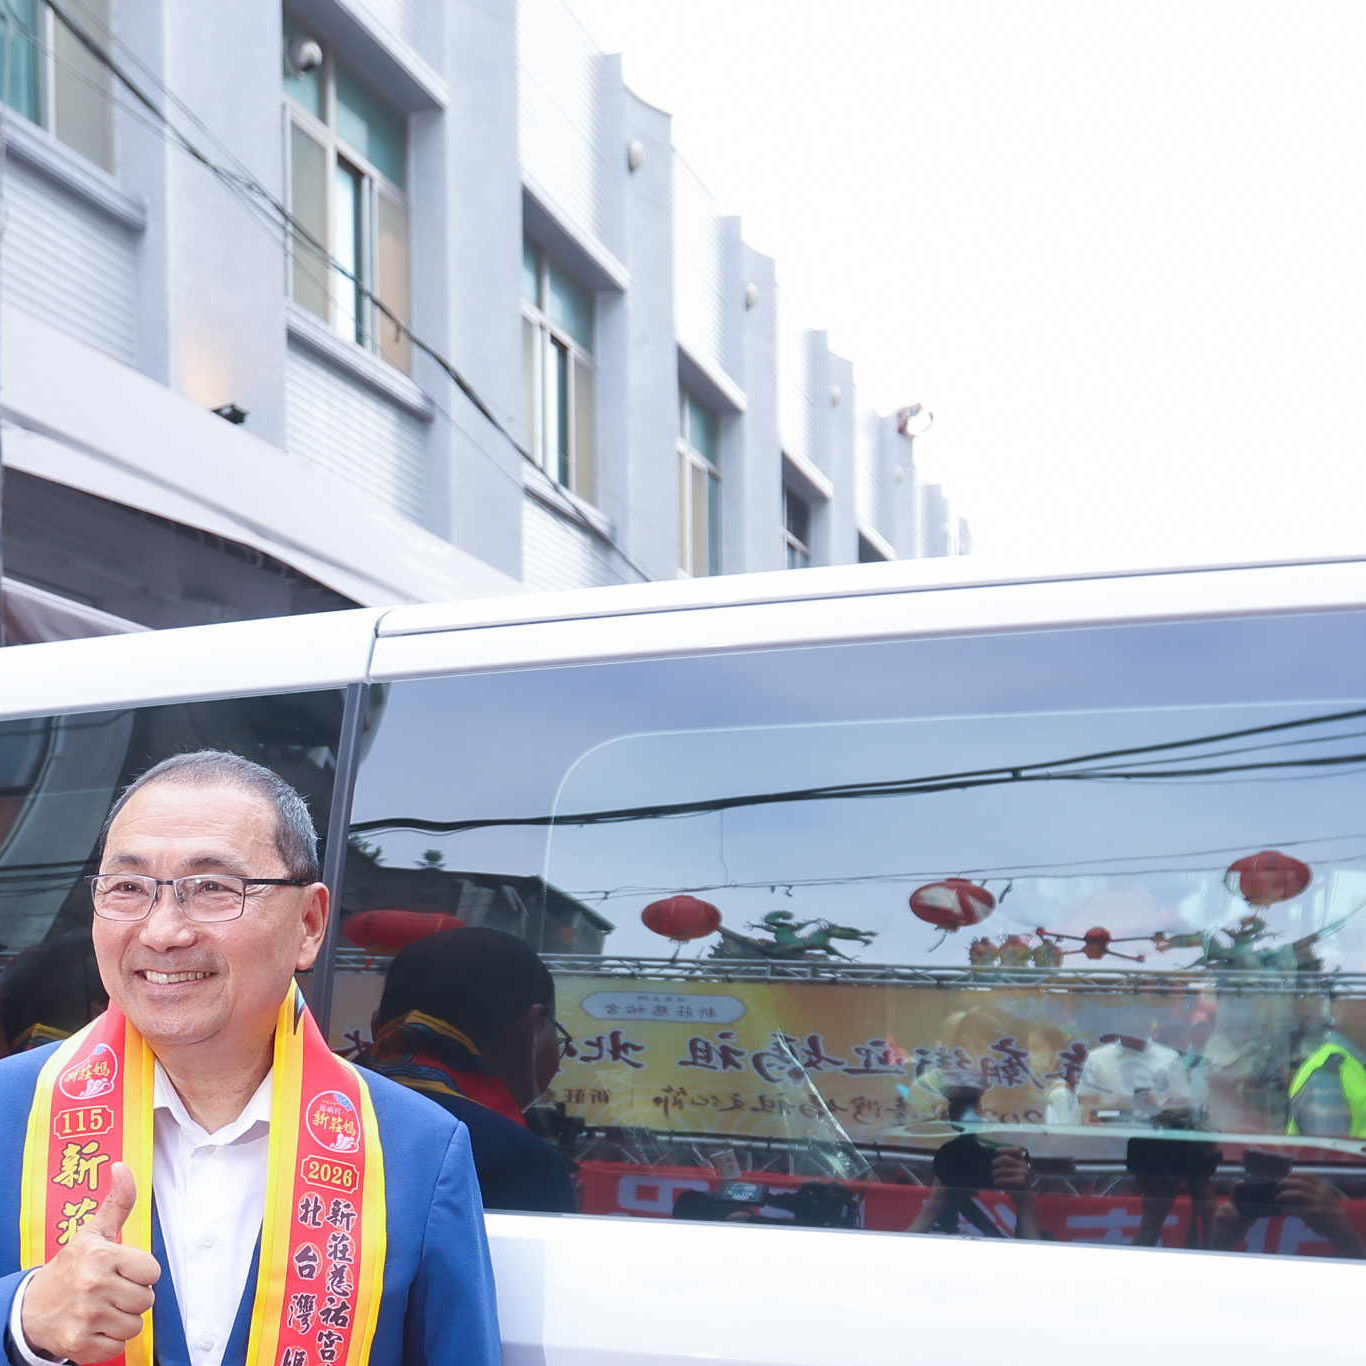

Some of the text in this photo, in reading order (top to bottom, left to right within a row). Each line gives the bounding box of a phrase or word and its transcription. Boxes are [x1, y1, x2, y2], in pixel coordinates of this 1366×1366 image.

[62, 1108, 103, 1134] 115
[312, 1111, 356, 1136] 新莊媽
[308, 1161, 353, 1187] 2026
